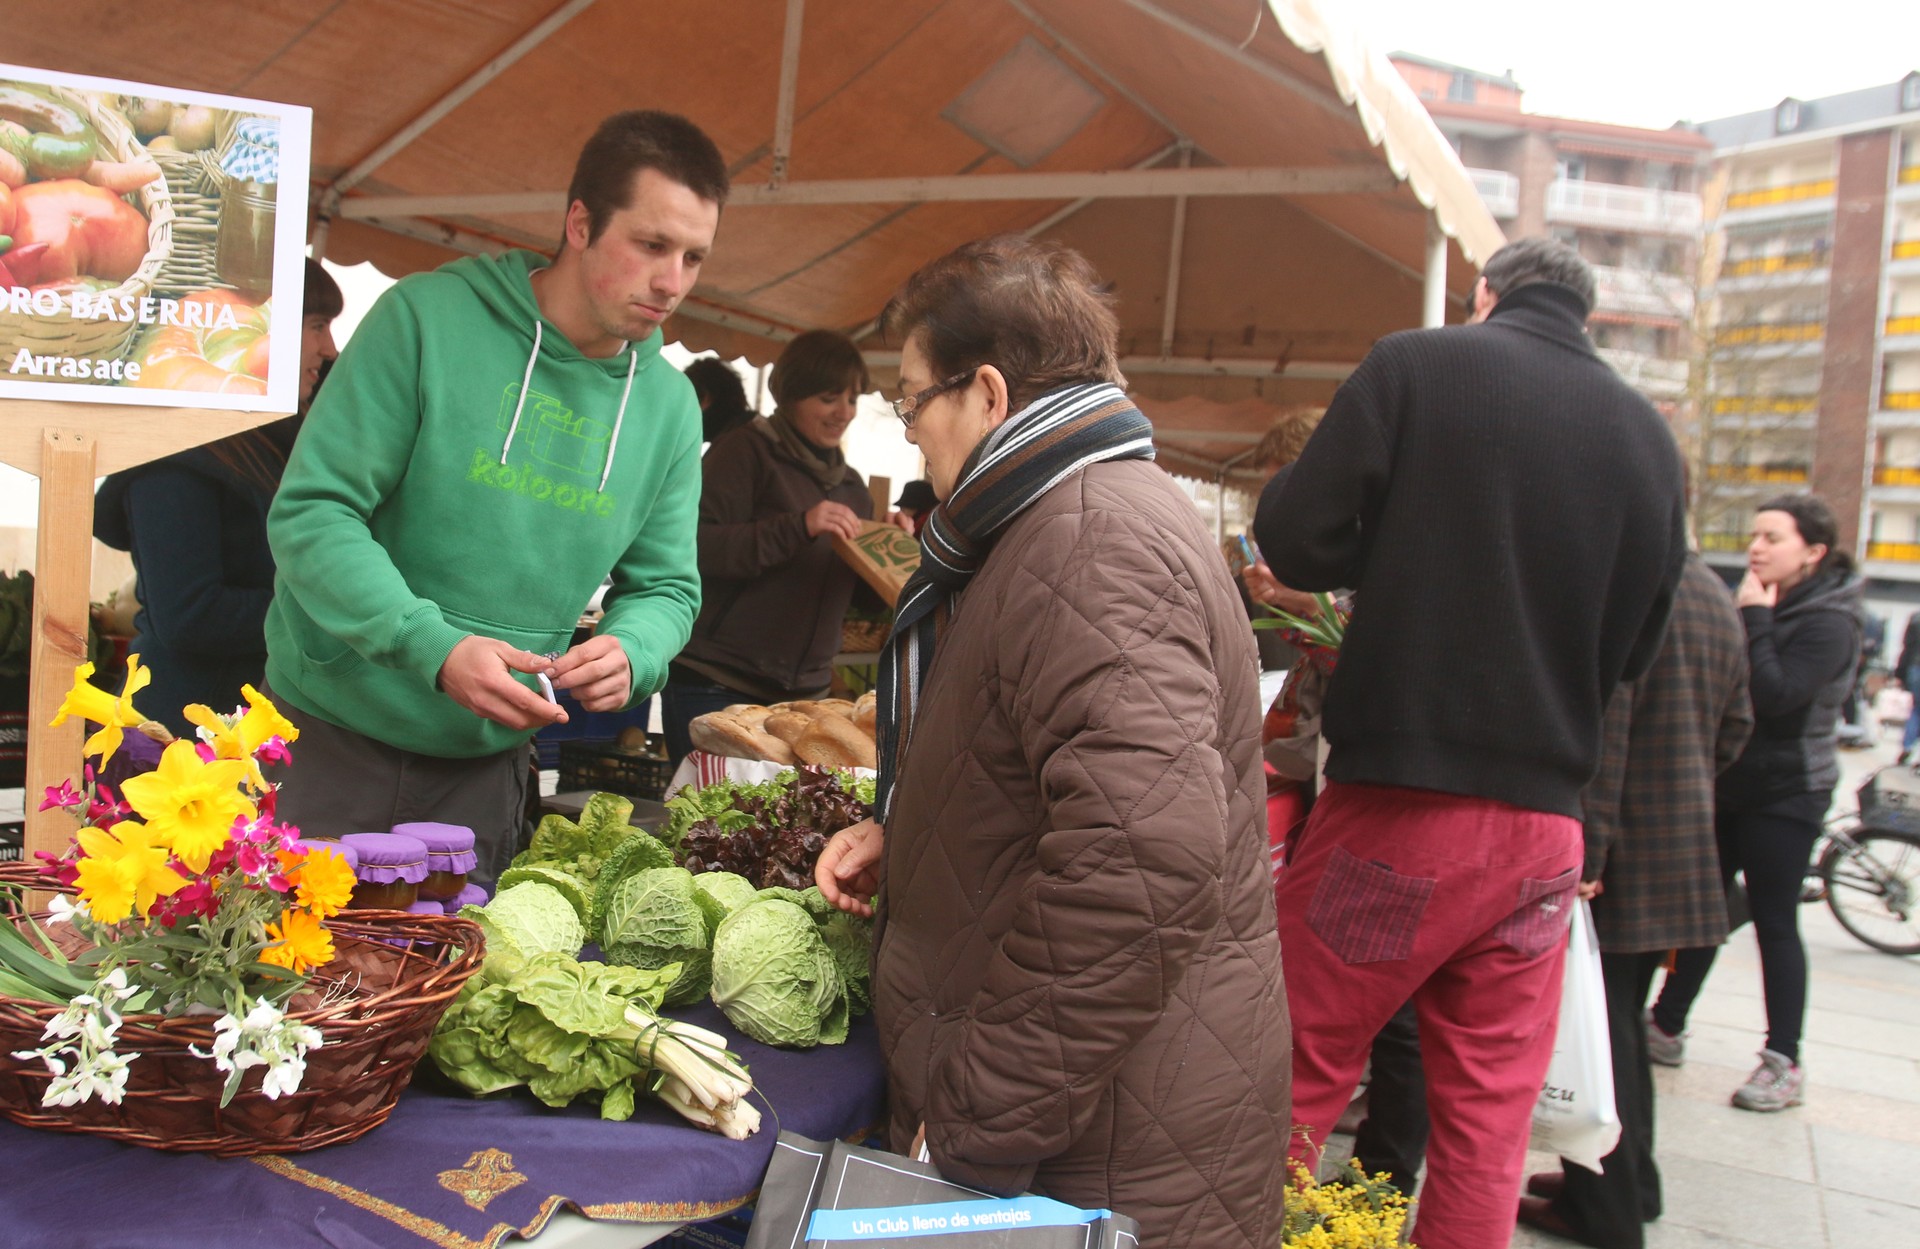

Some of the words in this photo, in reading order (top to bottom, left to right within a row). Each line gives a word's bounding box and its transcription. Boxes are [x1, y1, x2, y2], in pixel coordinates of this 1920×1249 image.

[71, 291, 240, 330] BASERRIA
[9, 347, 142, 381] Arrasate
[852, 1220, 874, 1234] Un
[876, 1217, 909, 1233] Club
[912, 1215, 947, 1231] lleno
[950, 1212, 970, 1228] de
[972, 1207, 1032, 1226] ventajas
